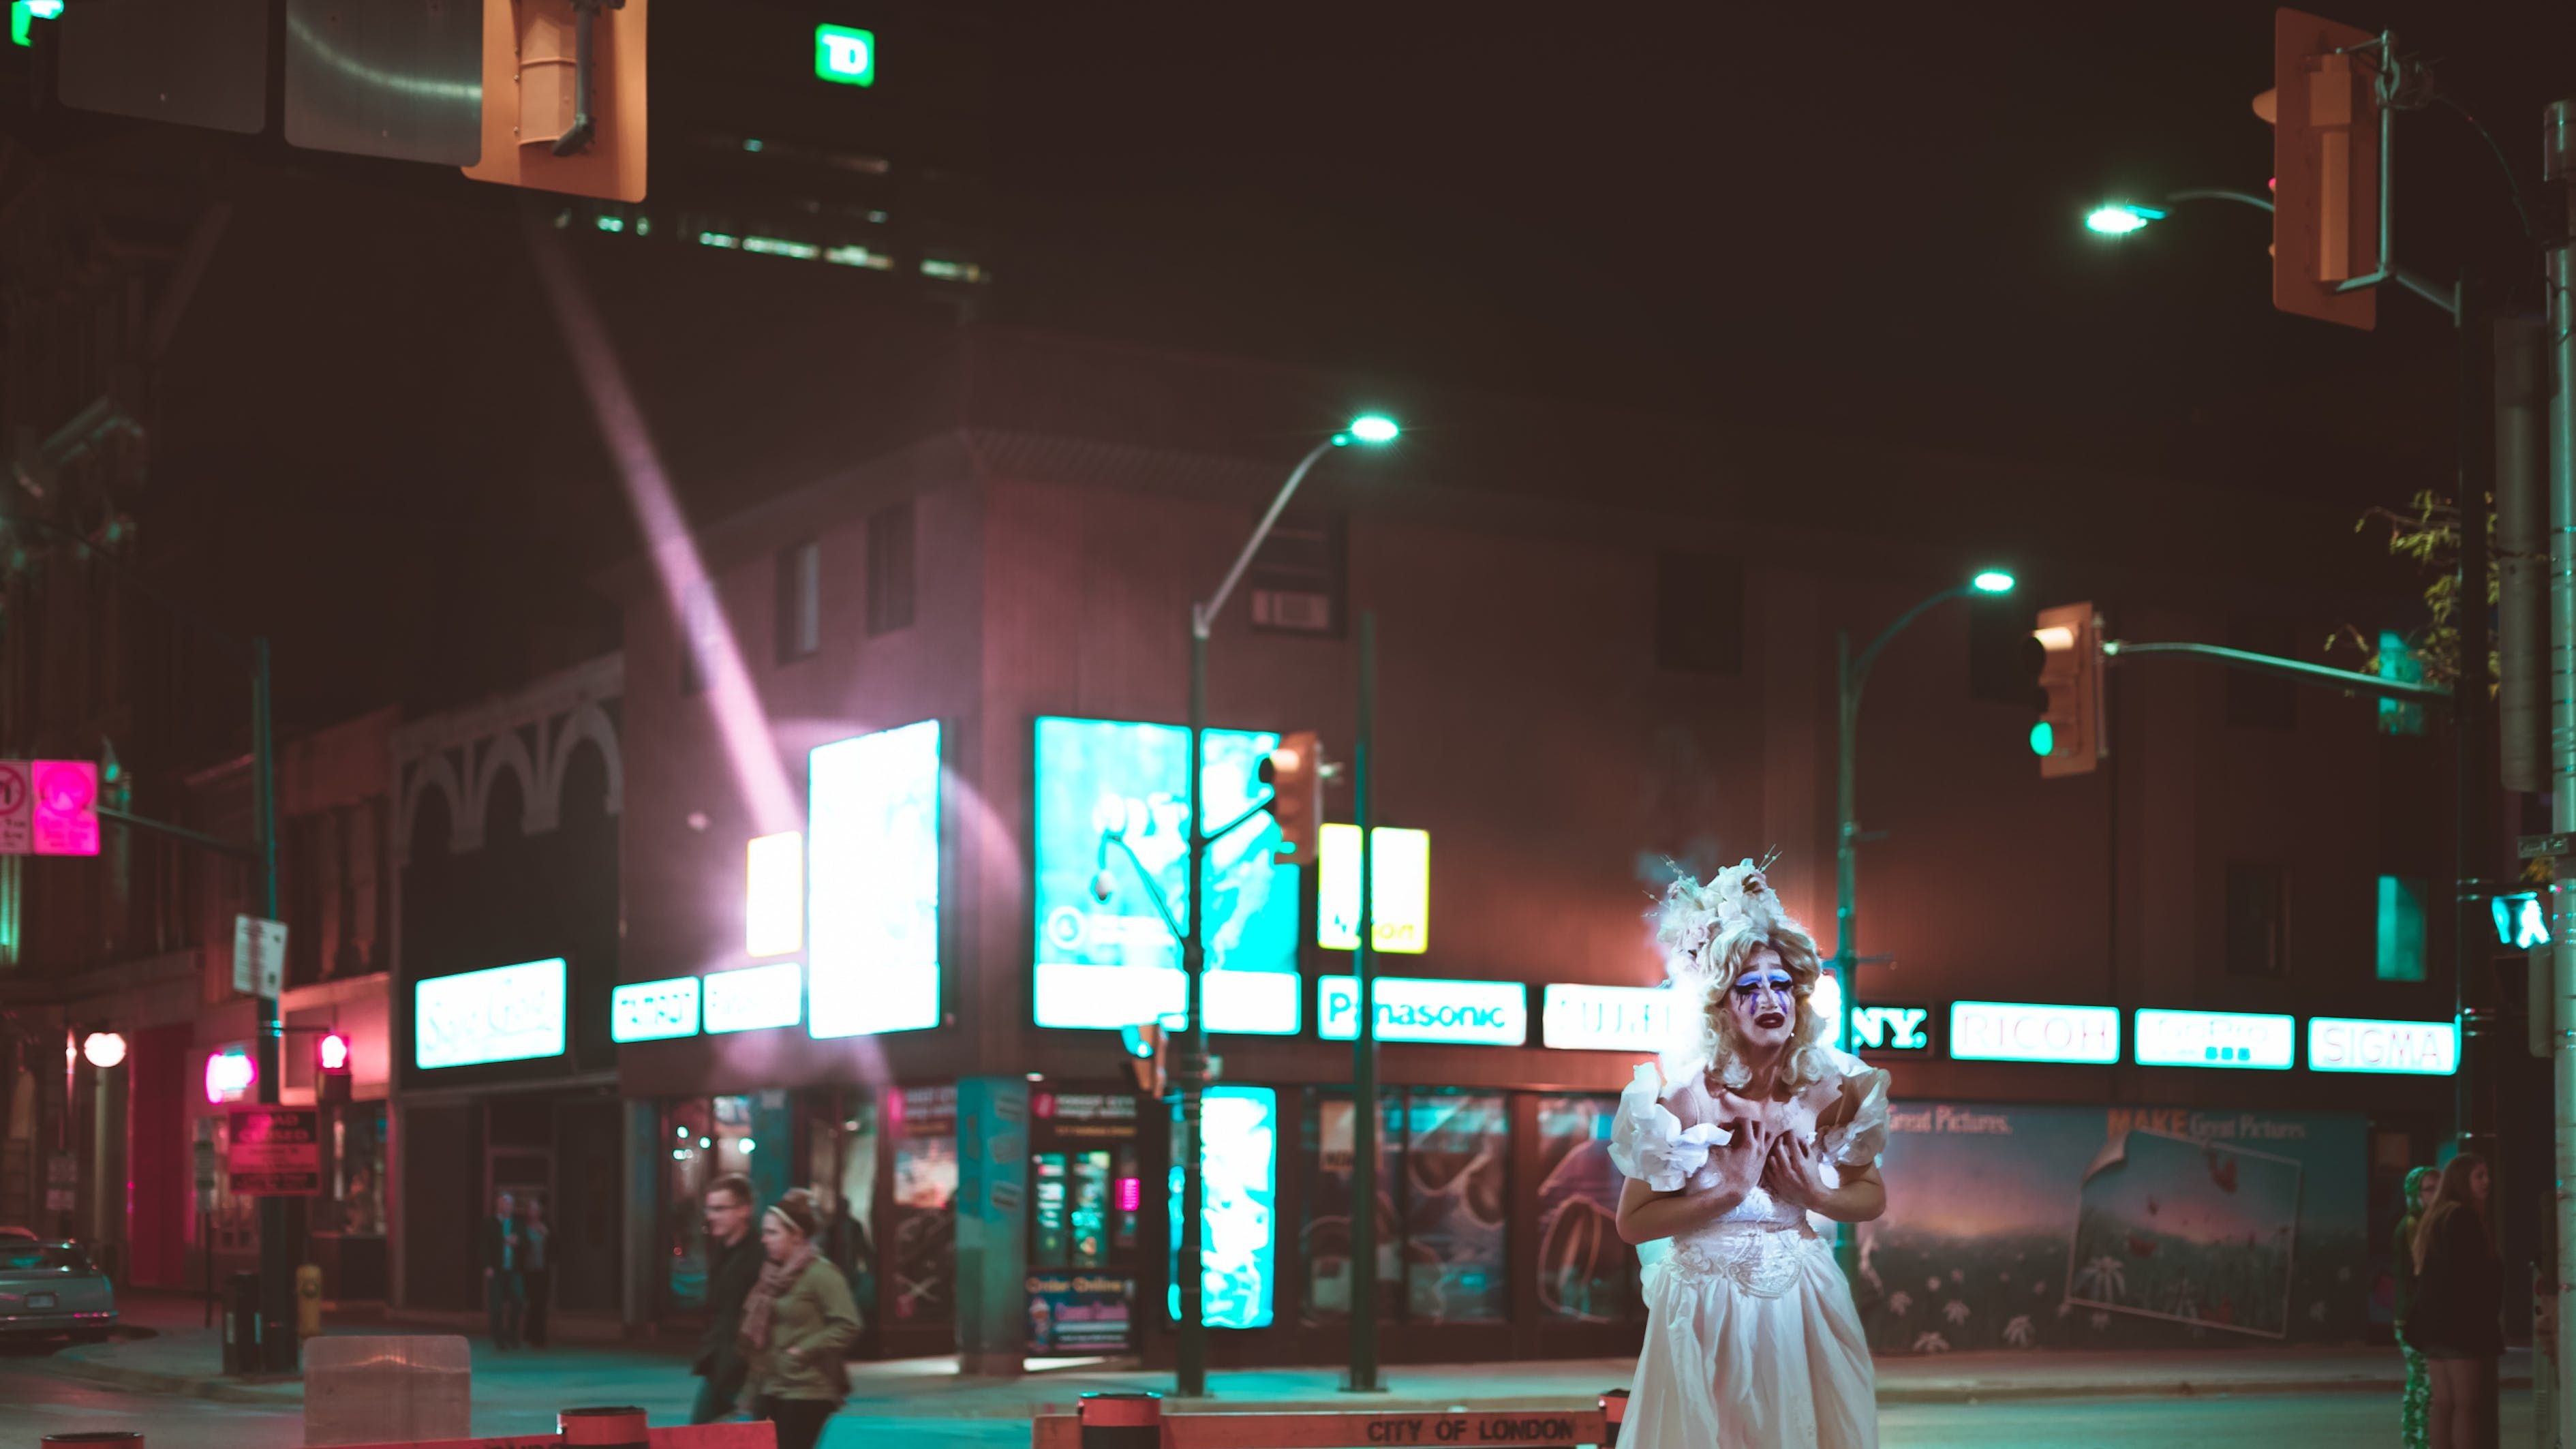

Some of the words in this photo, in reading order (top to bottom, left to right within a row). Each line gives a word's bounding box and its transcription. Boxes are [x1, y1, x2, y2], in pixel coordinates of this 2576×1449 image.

[822, 33, 868, 75] TD
[1330, 992, 1505, 1028] Pnasonic
[1962, 1012, 2110, 1052] RICOH
[2322, 1025, 2442, 1067] SIGMA
[2107, 1107, 2189, 1138] MAKE
[1026, 1277, 1070, 1293] Order
[1072, 1276, 1123, 1293] Online
[1366, 1420, 1423, 1442] CITY
[1436, 1420, 1467, 1442] OF
[1478, 1419, 1576, 1442] LONDON
